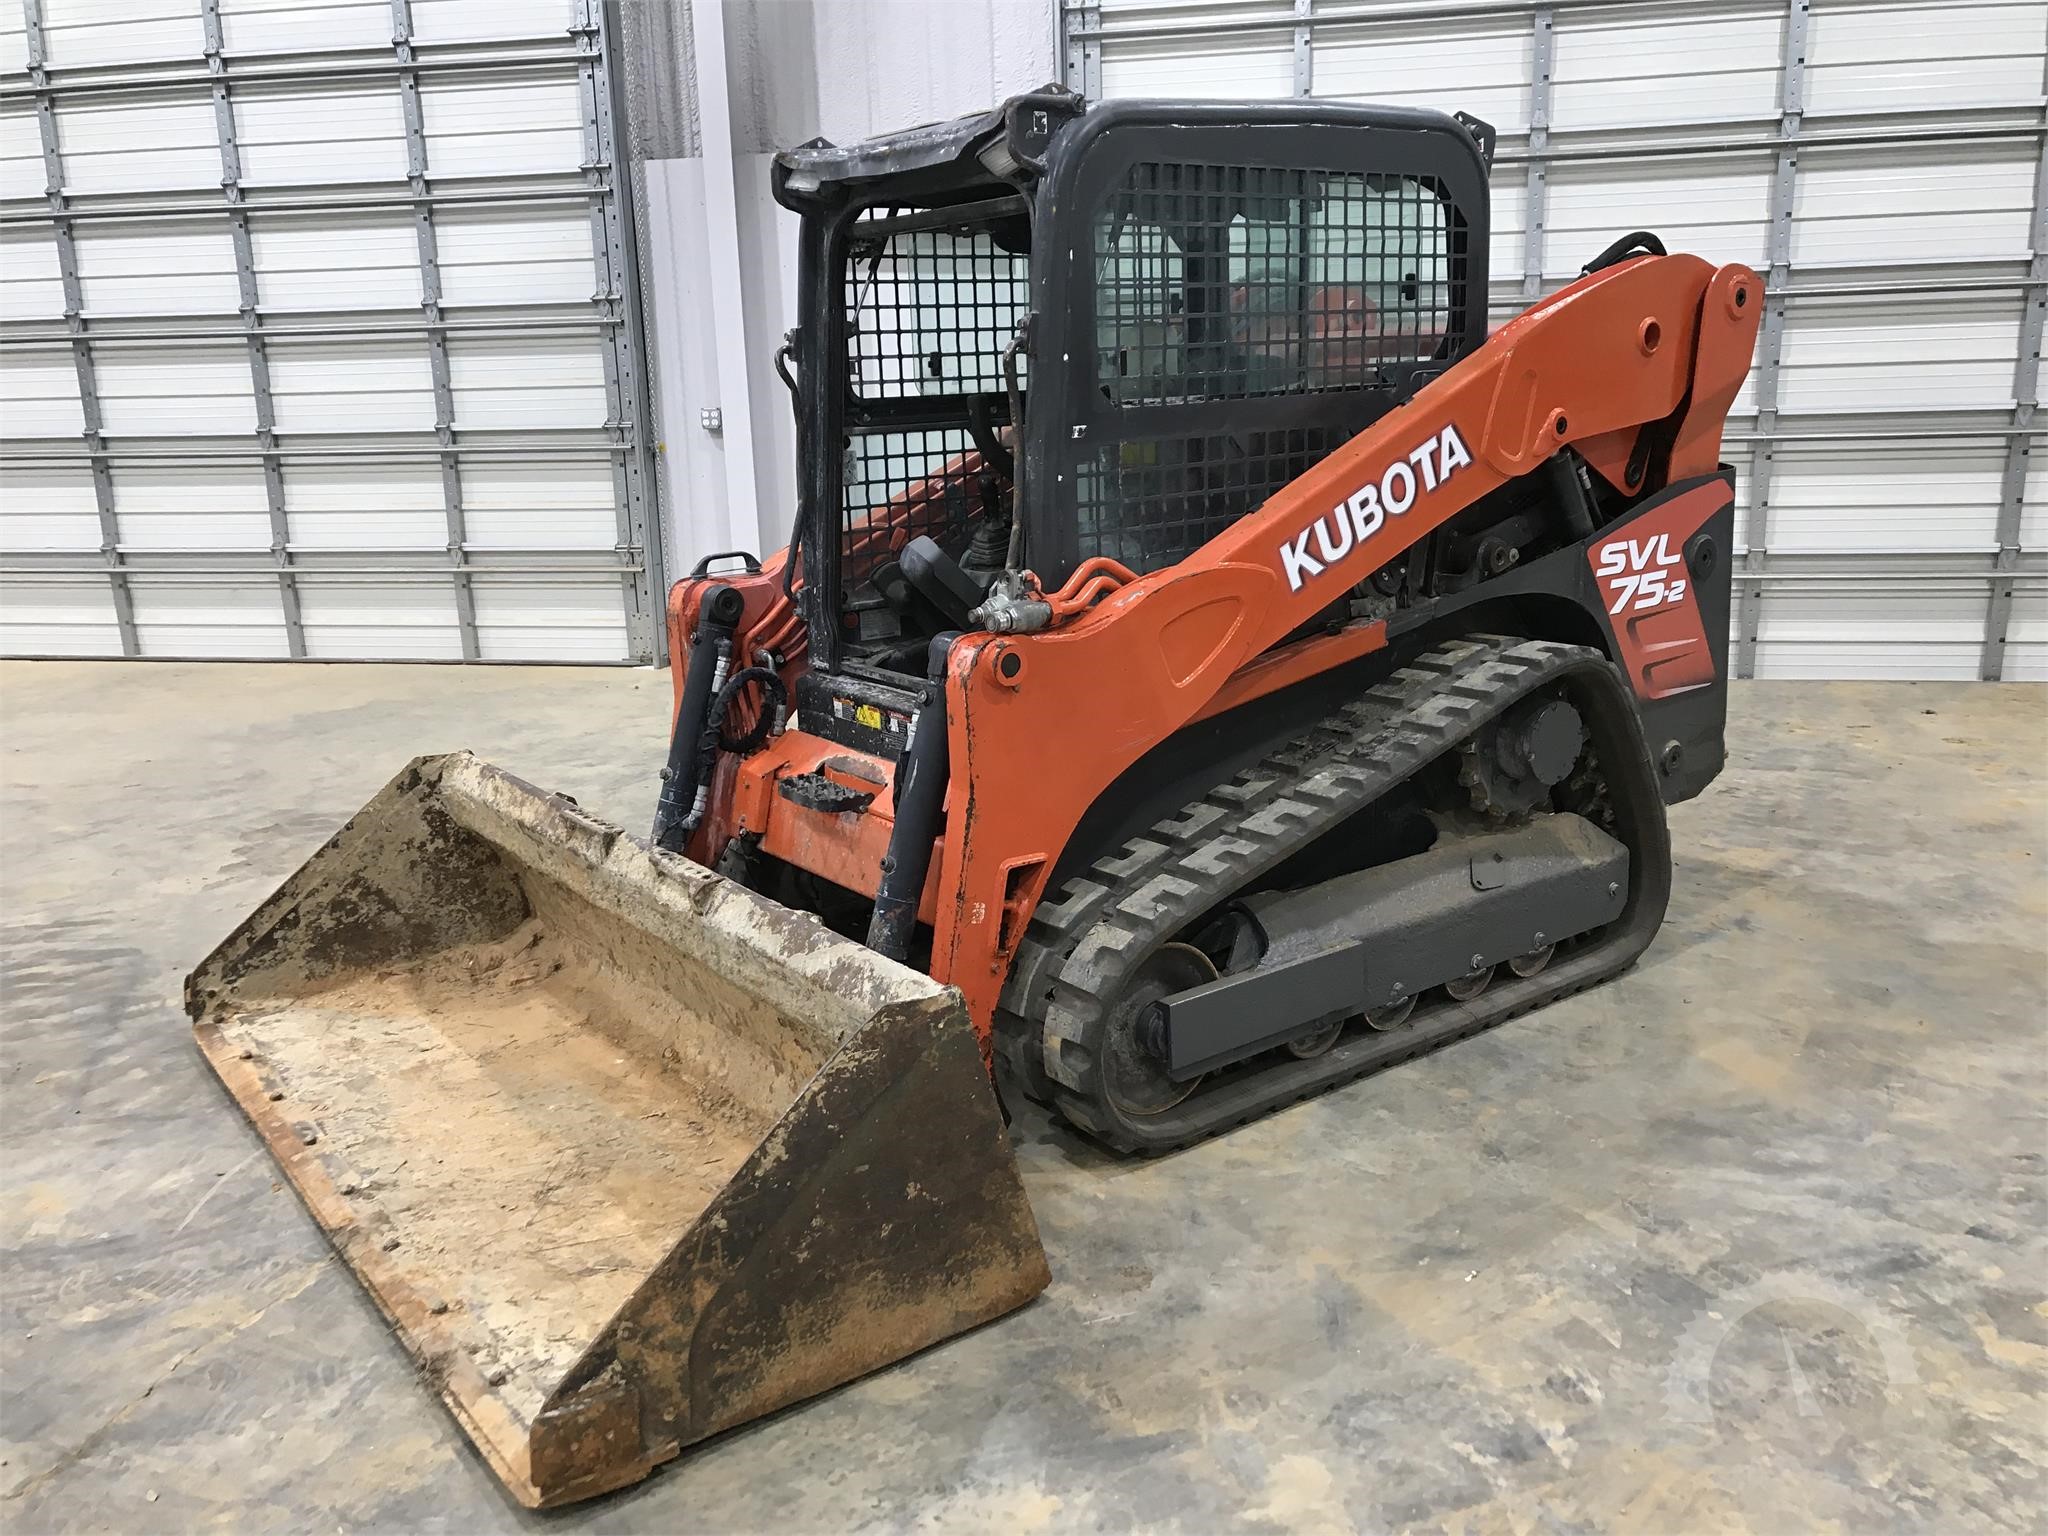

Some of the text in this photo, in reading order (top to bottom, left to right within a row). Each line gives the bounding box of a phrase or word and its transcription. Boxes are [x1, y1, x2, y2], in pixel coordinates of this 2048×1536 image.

[1279, 423, 1472, 592] KUBOTA
[1596, 533, 1680, 577] SVL
[1609, 569, 1686, 615] 75-2
